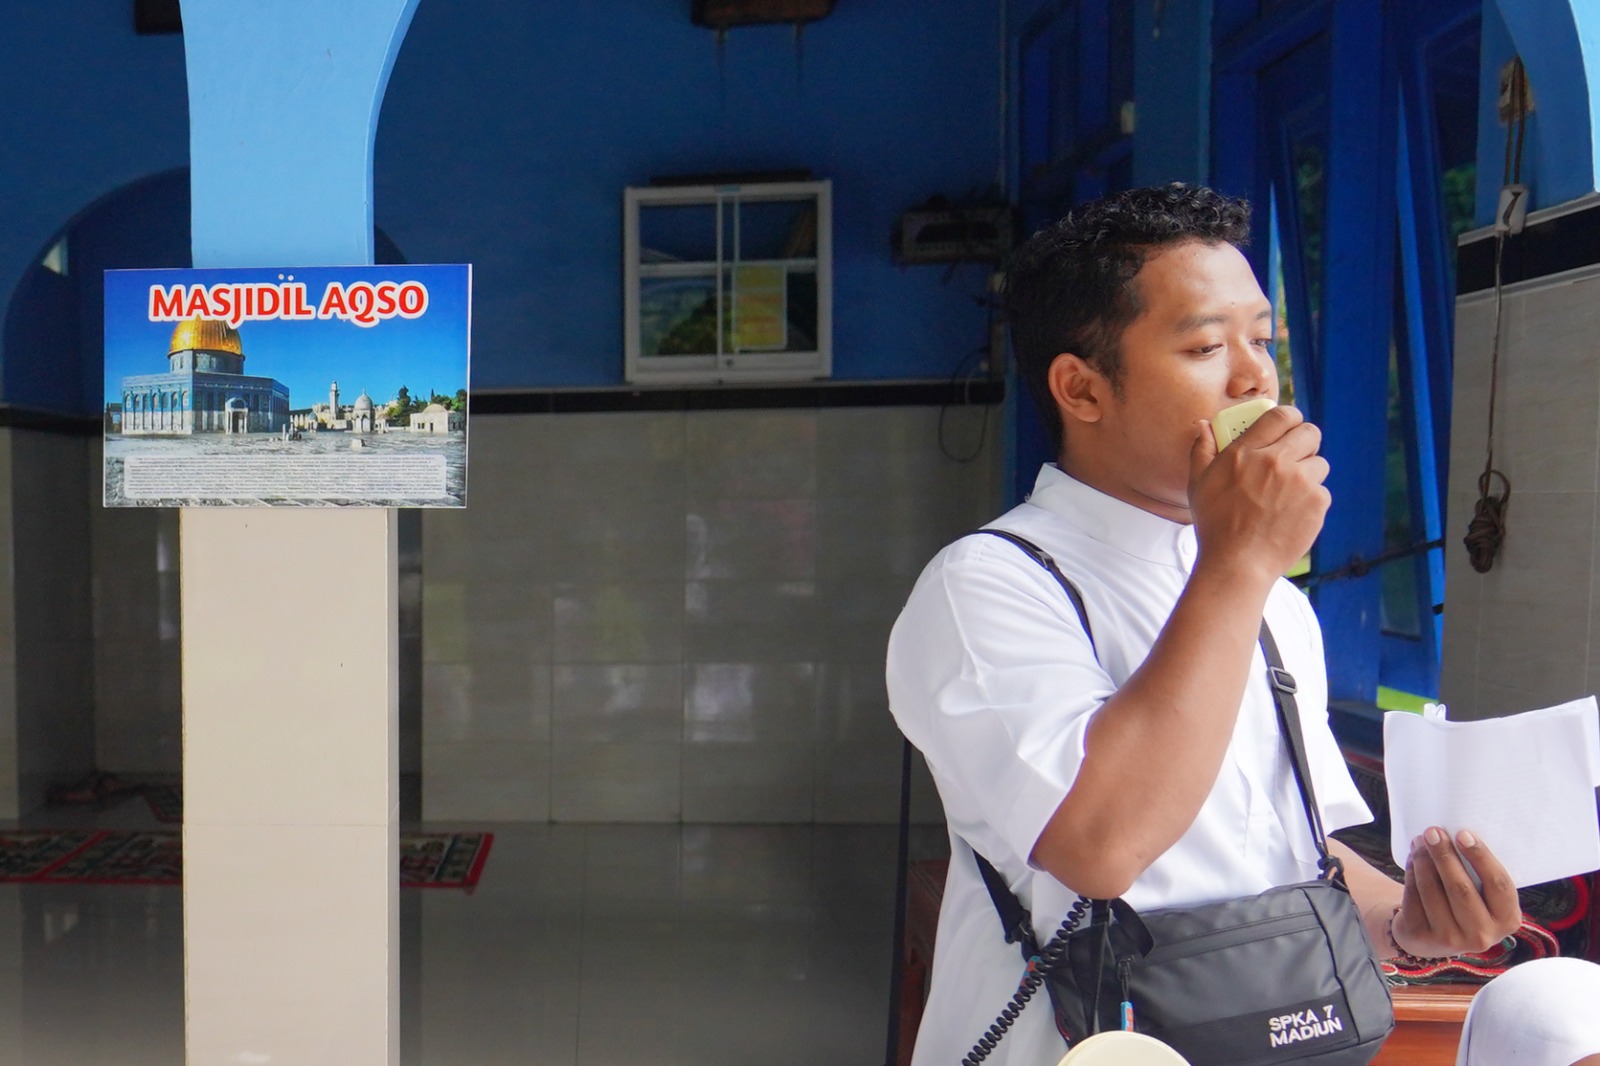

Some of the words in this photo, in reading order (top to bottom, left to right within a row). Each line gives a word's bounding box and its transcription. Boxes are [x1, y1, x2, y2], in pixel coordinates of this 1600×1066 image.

[320, 283, 425, 324] AQSO
[1269, 1009, 1318, 1031] SPKA
[1323, 1005, 1334, 1019] 7
[1269, 1017, 1343, 1048] MADIUN
